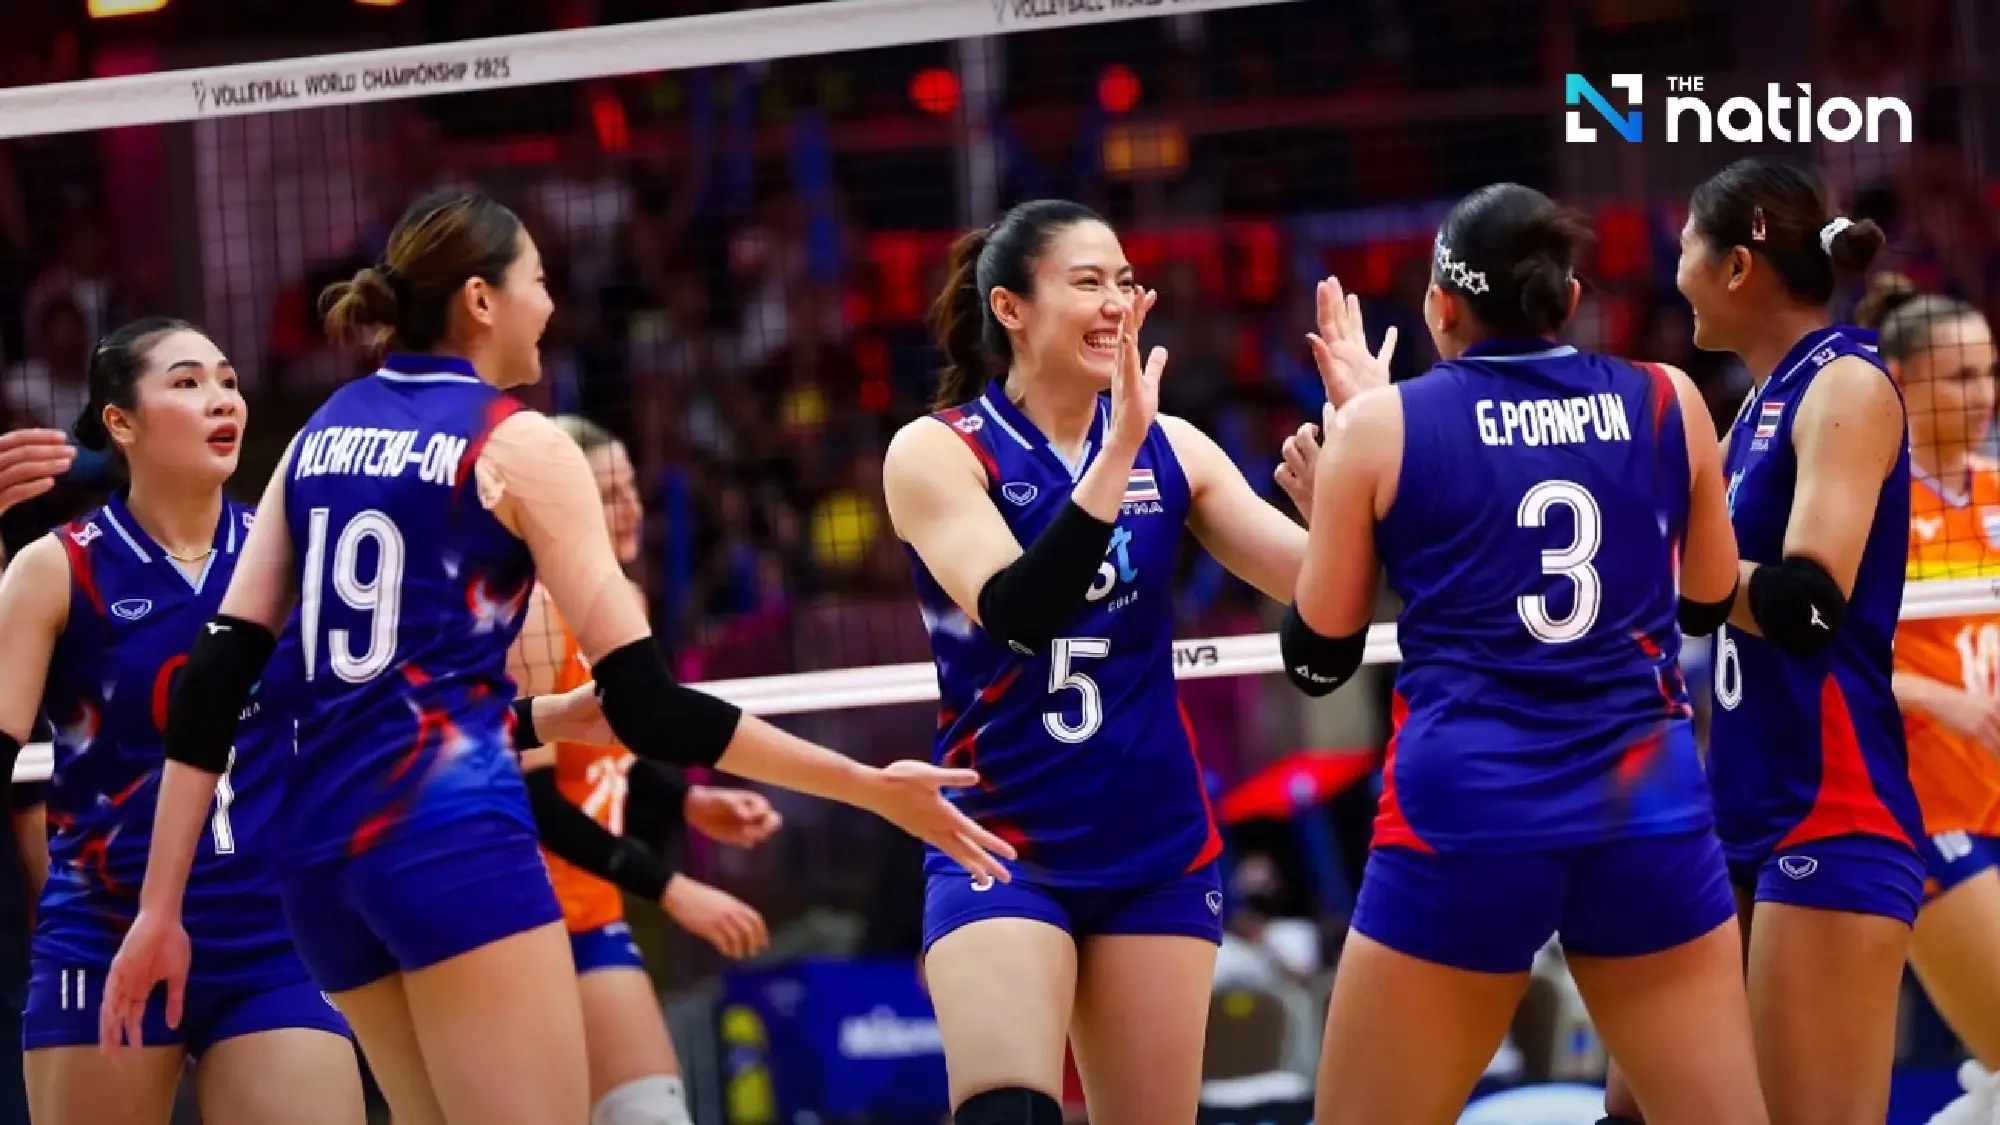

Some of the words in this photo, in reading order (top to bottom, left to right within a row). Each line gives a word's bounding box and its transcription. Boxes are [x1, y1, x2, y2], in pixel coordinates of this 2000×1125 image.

[211, 79, 299, 107] VOLLEYBALL
[305, 72, 356, 94] WORLD
[362, 61, 468, 91] CHAMPIONSHIP
[474, 56, 511, 79] 2025
[1476, 392, 1632, 446] G.PORNPUN
[301, 507, 406, 683] 19
[1517, 479, 1602, 643] 3
[1042, 637, 1111, 744] 5
